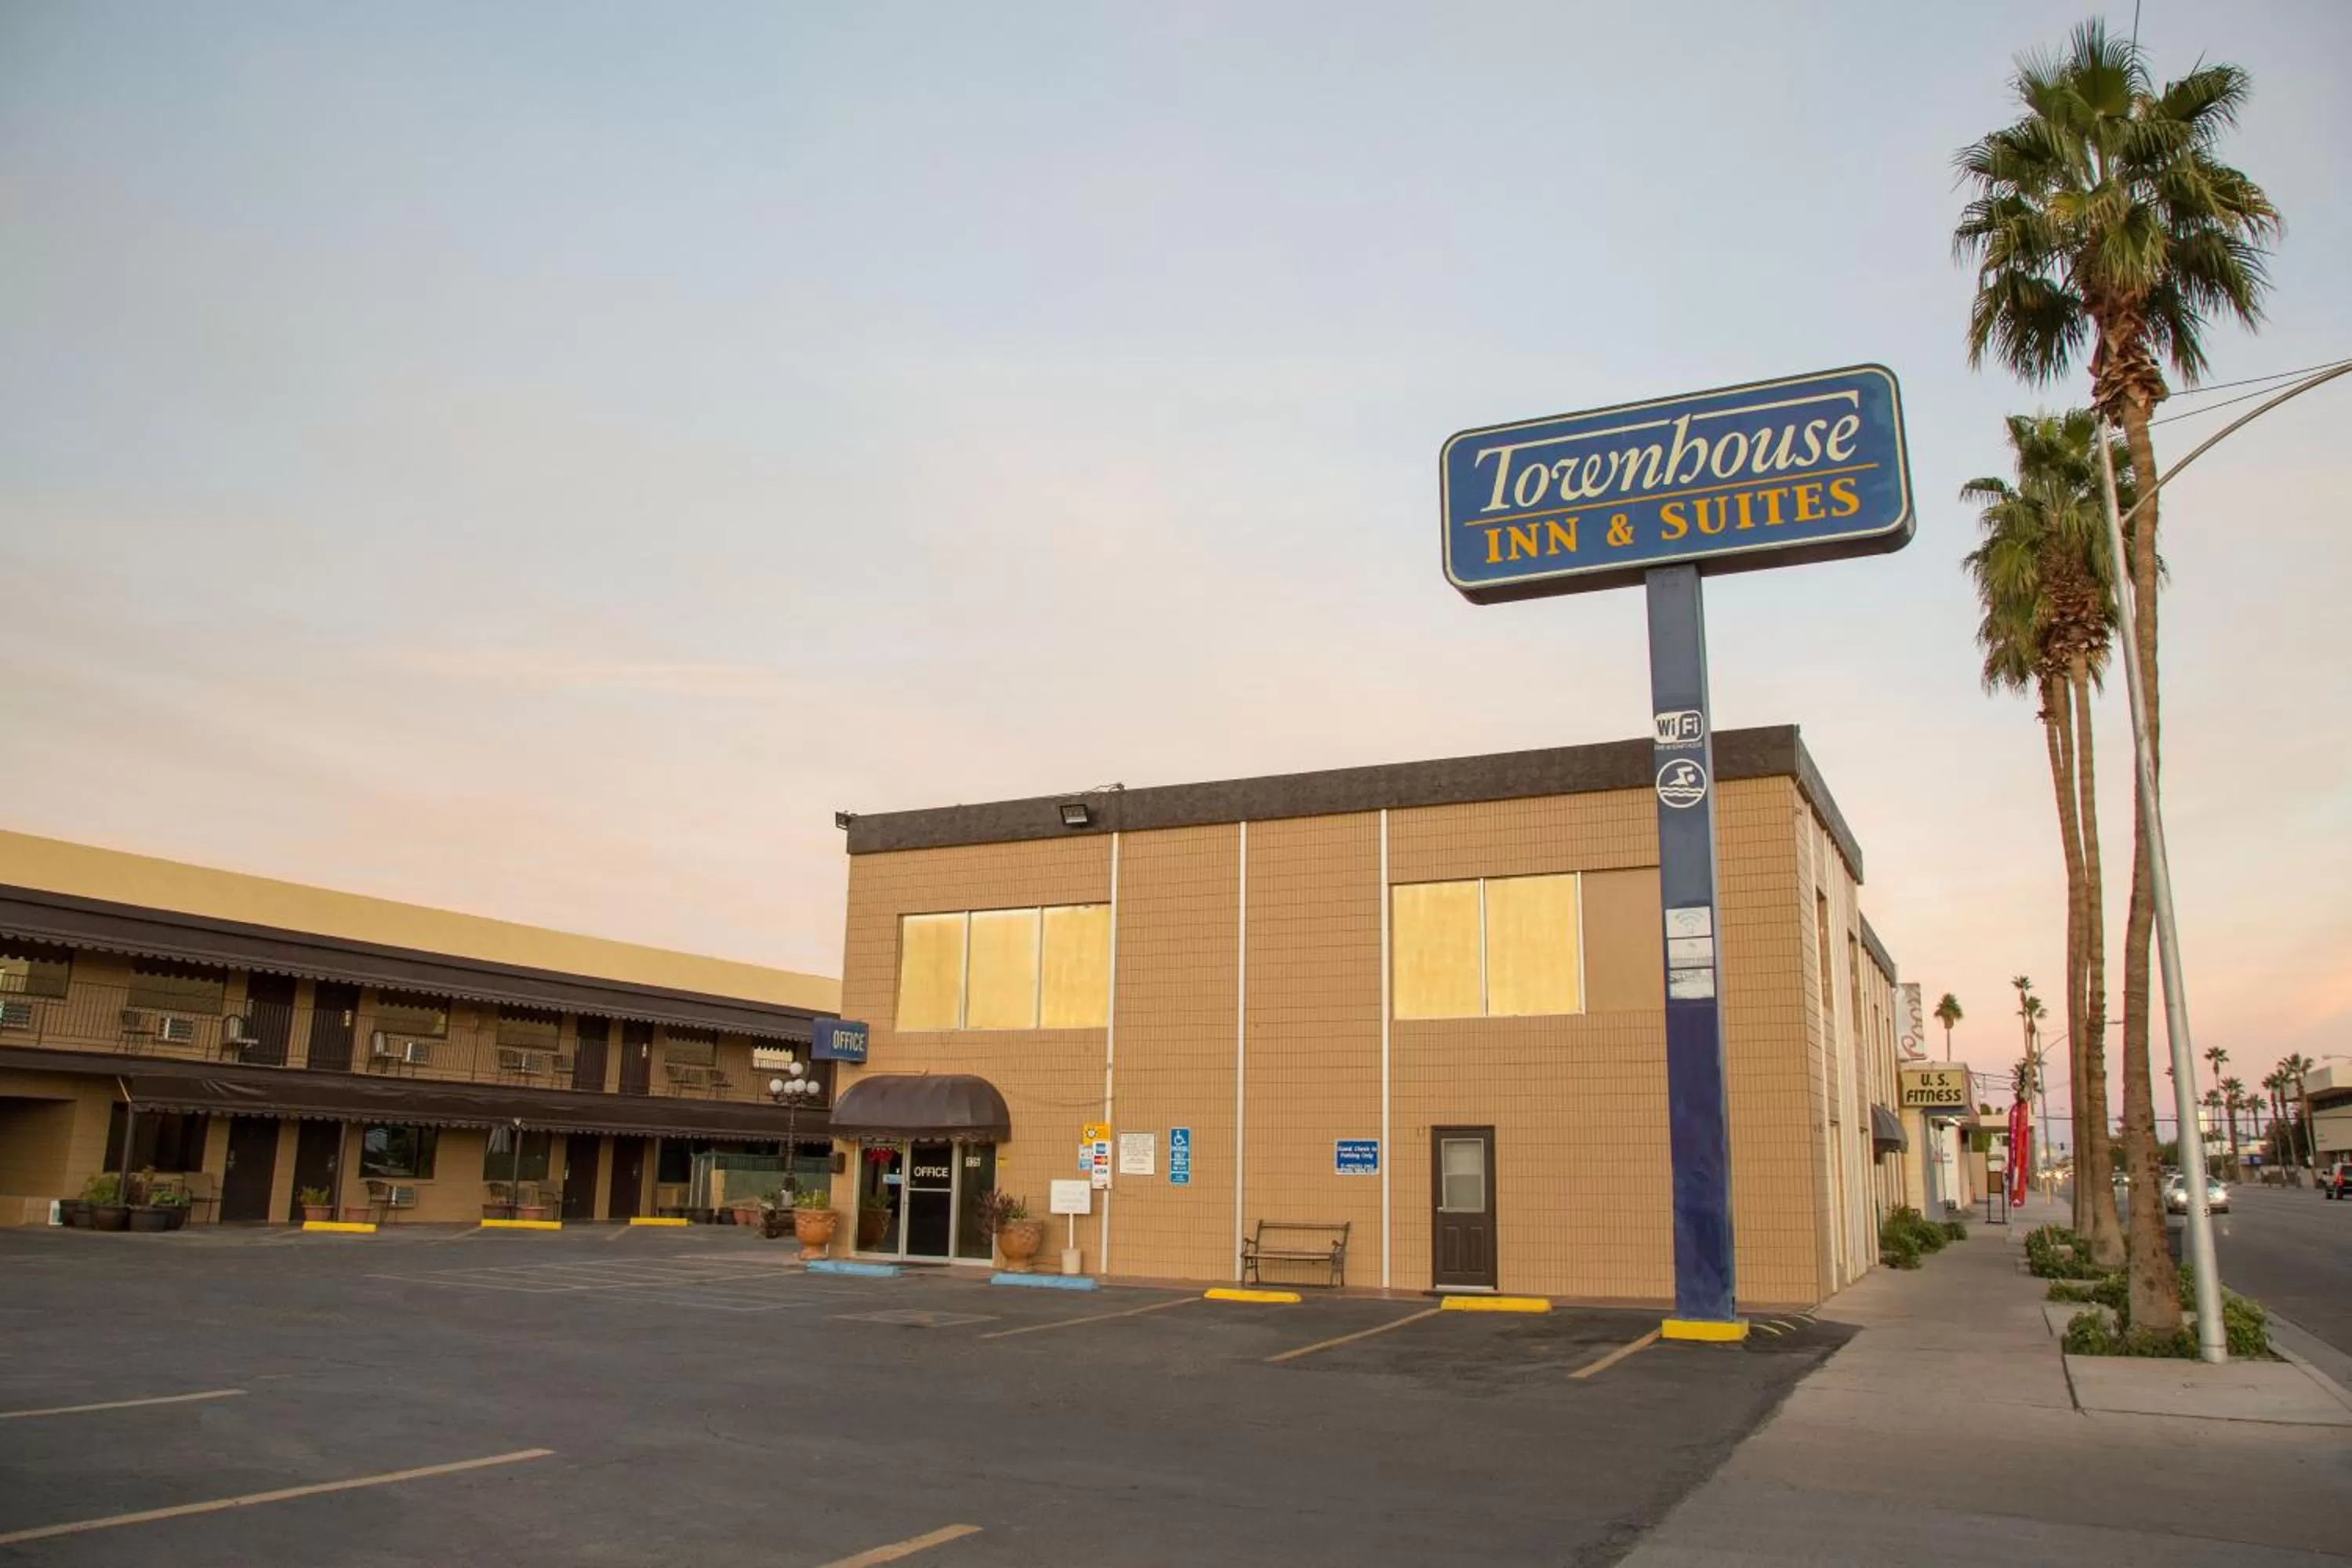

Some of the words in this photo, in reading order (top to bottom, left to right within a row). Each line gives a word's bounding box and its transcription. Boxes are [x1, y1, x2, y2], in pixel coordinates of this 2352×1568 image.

[1474, 390, 1860, 513] Townhouse
[1484, 517, 1579, 564] INN
[1606, 514, 1635, 546] &
[1660, 477, 1861, 540] SUITES
[833, 1029, 865, 1051] OFFICE
[1921, 1074, 1933, 1086] U.
[1937, 1074, 1950, 1086] S.
[1907, 1089, 1962, 1102] FITNESS
[914, 1166, 949, 1177] OFFICE
